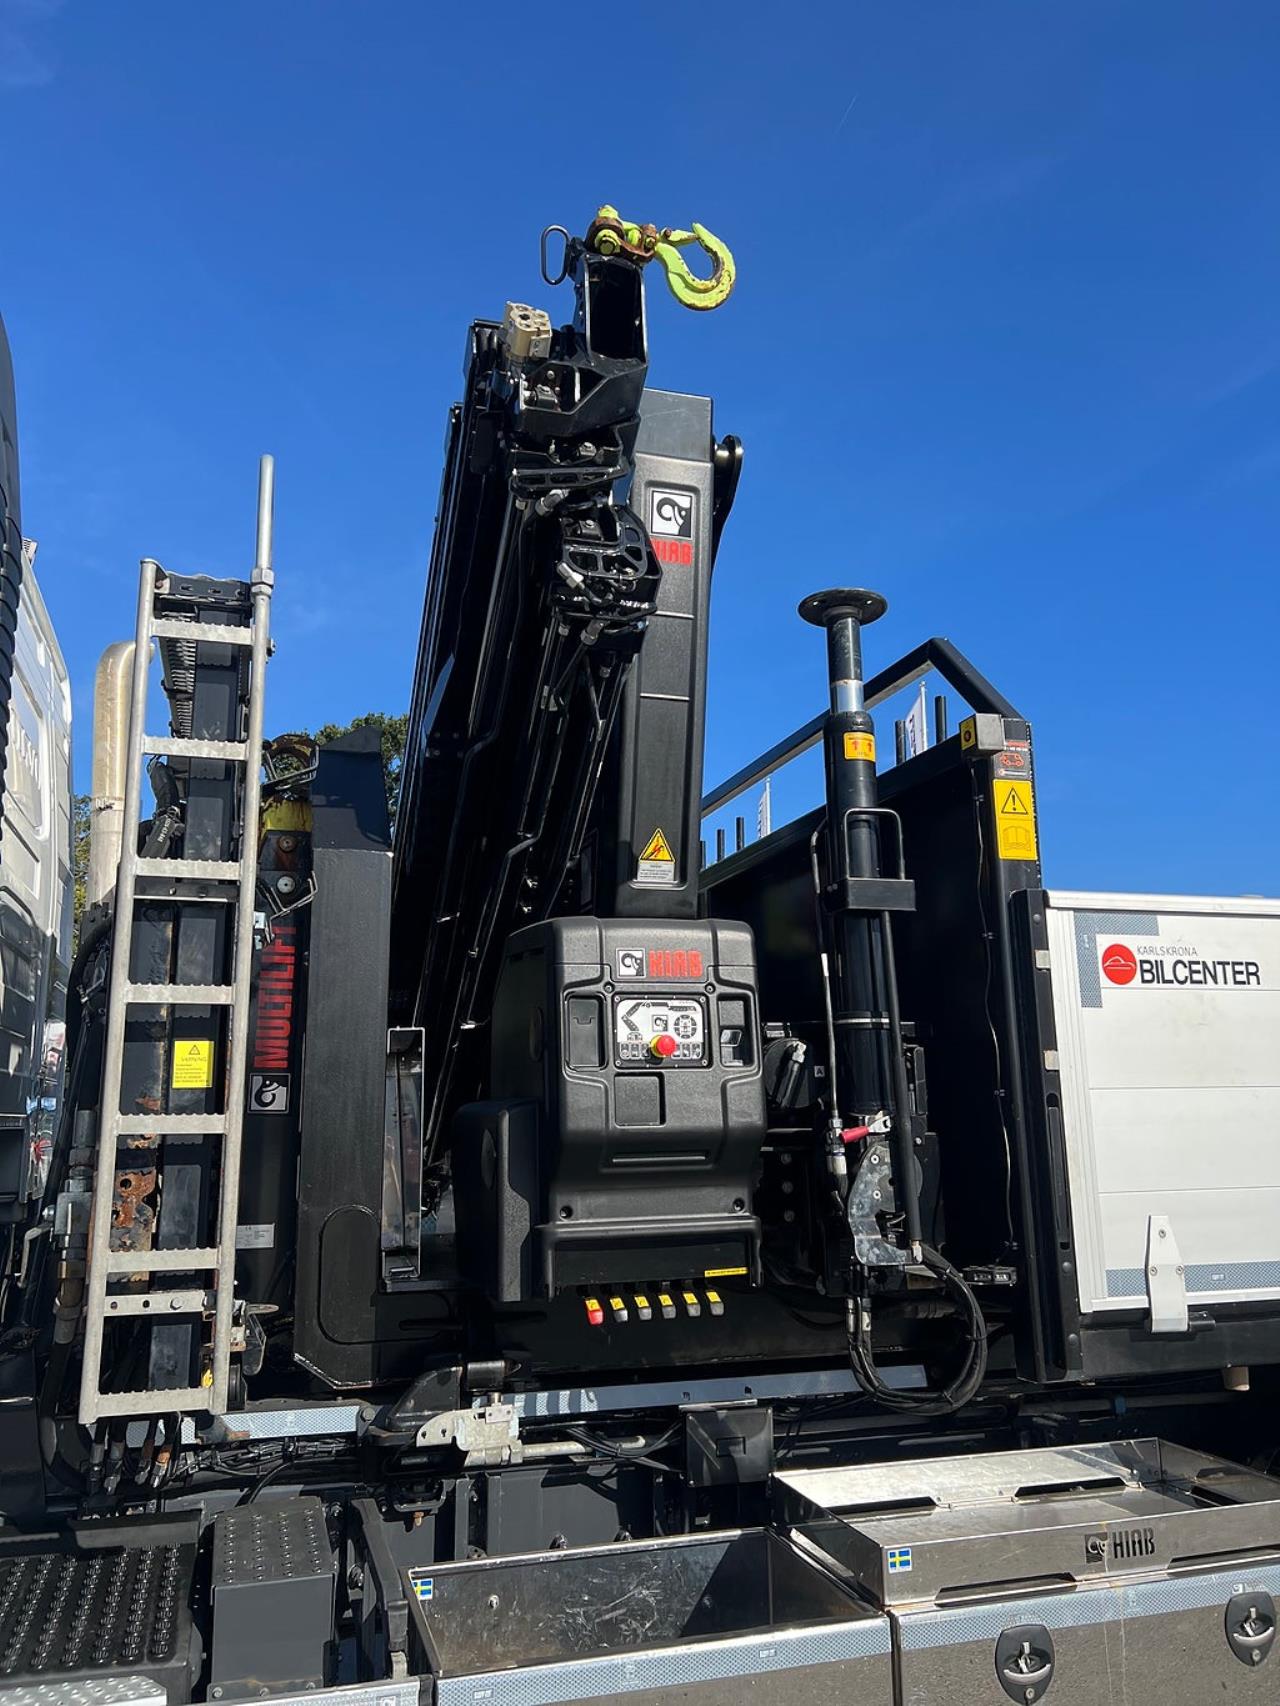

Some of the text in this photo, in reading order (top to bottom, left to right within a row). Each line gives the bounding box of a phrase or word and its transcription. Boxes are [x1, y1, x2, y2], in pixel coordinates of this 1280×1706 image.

[648, 950, 703, 977] HIAB
[1137, 945, 1198, 957] KARLSKRONA
[1139, 959, 1261, 985] BILCENTER
[1112, 1527, 1156, 1559] HIAB
